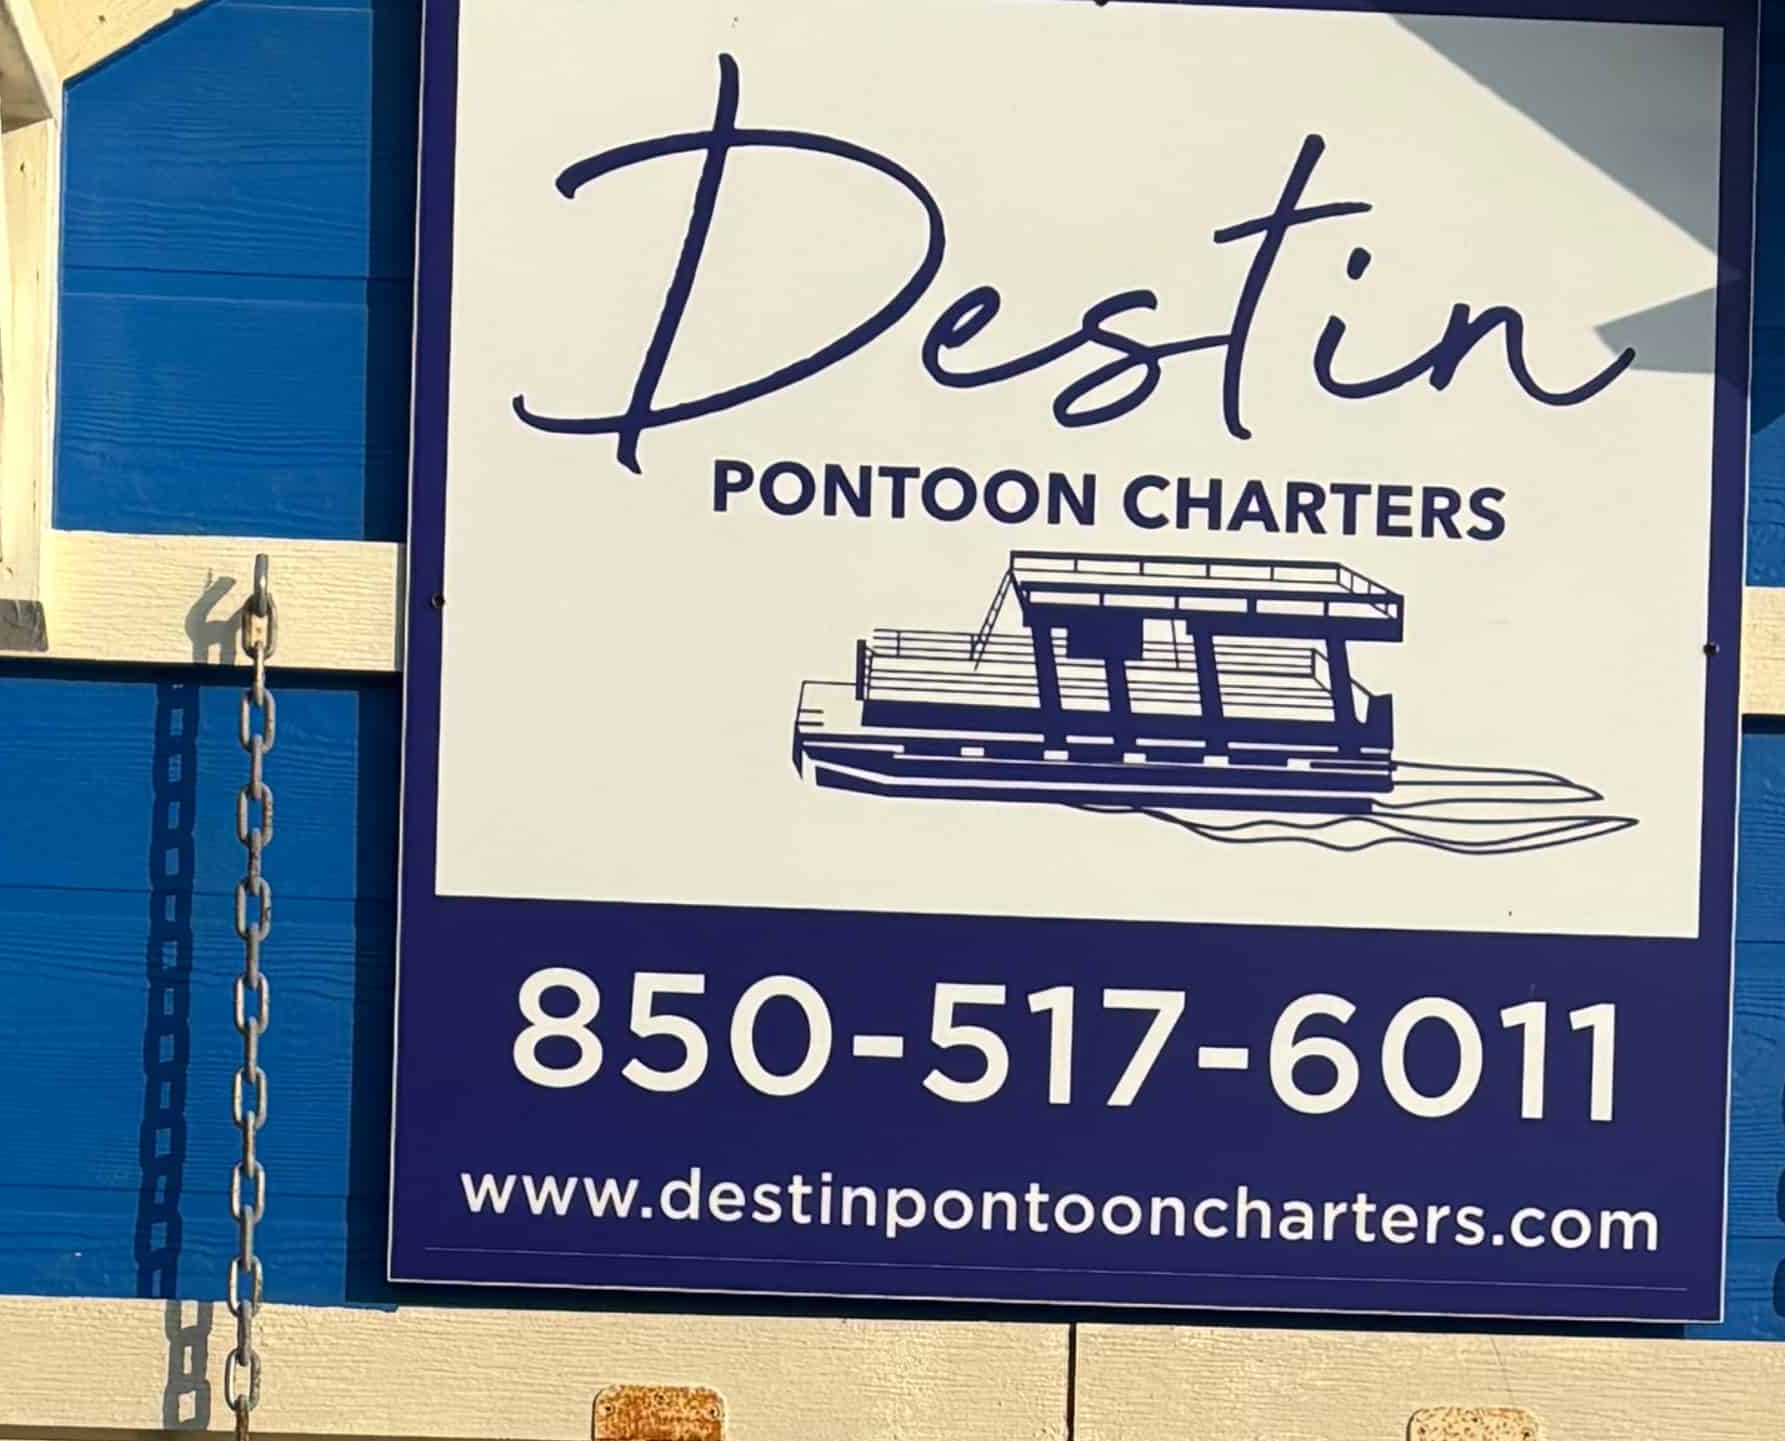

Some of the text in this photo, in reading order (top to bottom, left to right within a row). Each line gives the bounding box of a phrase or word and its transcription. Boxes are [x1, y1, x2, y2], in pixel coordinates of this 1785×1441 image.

[513, 52, 1637, 474] Destin
[713, 459, 1506, 541] PONTOON CHARTERS
[513, 967, 1617, 1122] 850-517-6011
[460, 1166, 1660, 1252] www.destinpontooncharters.com
